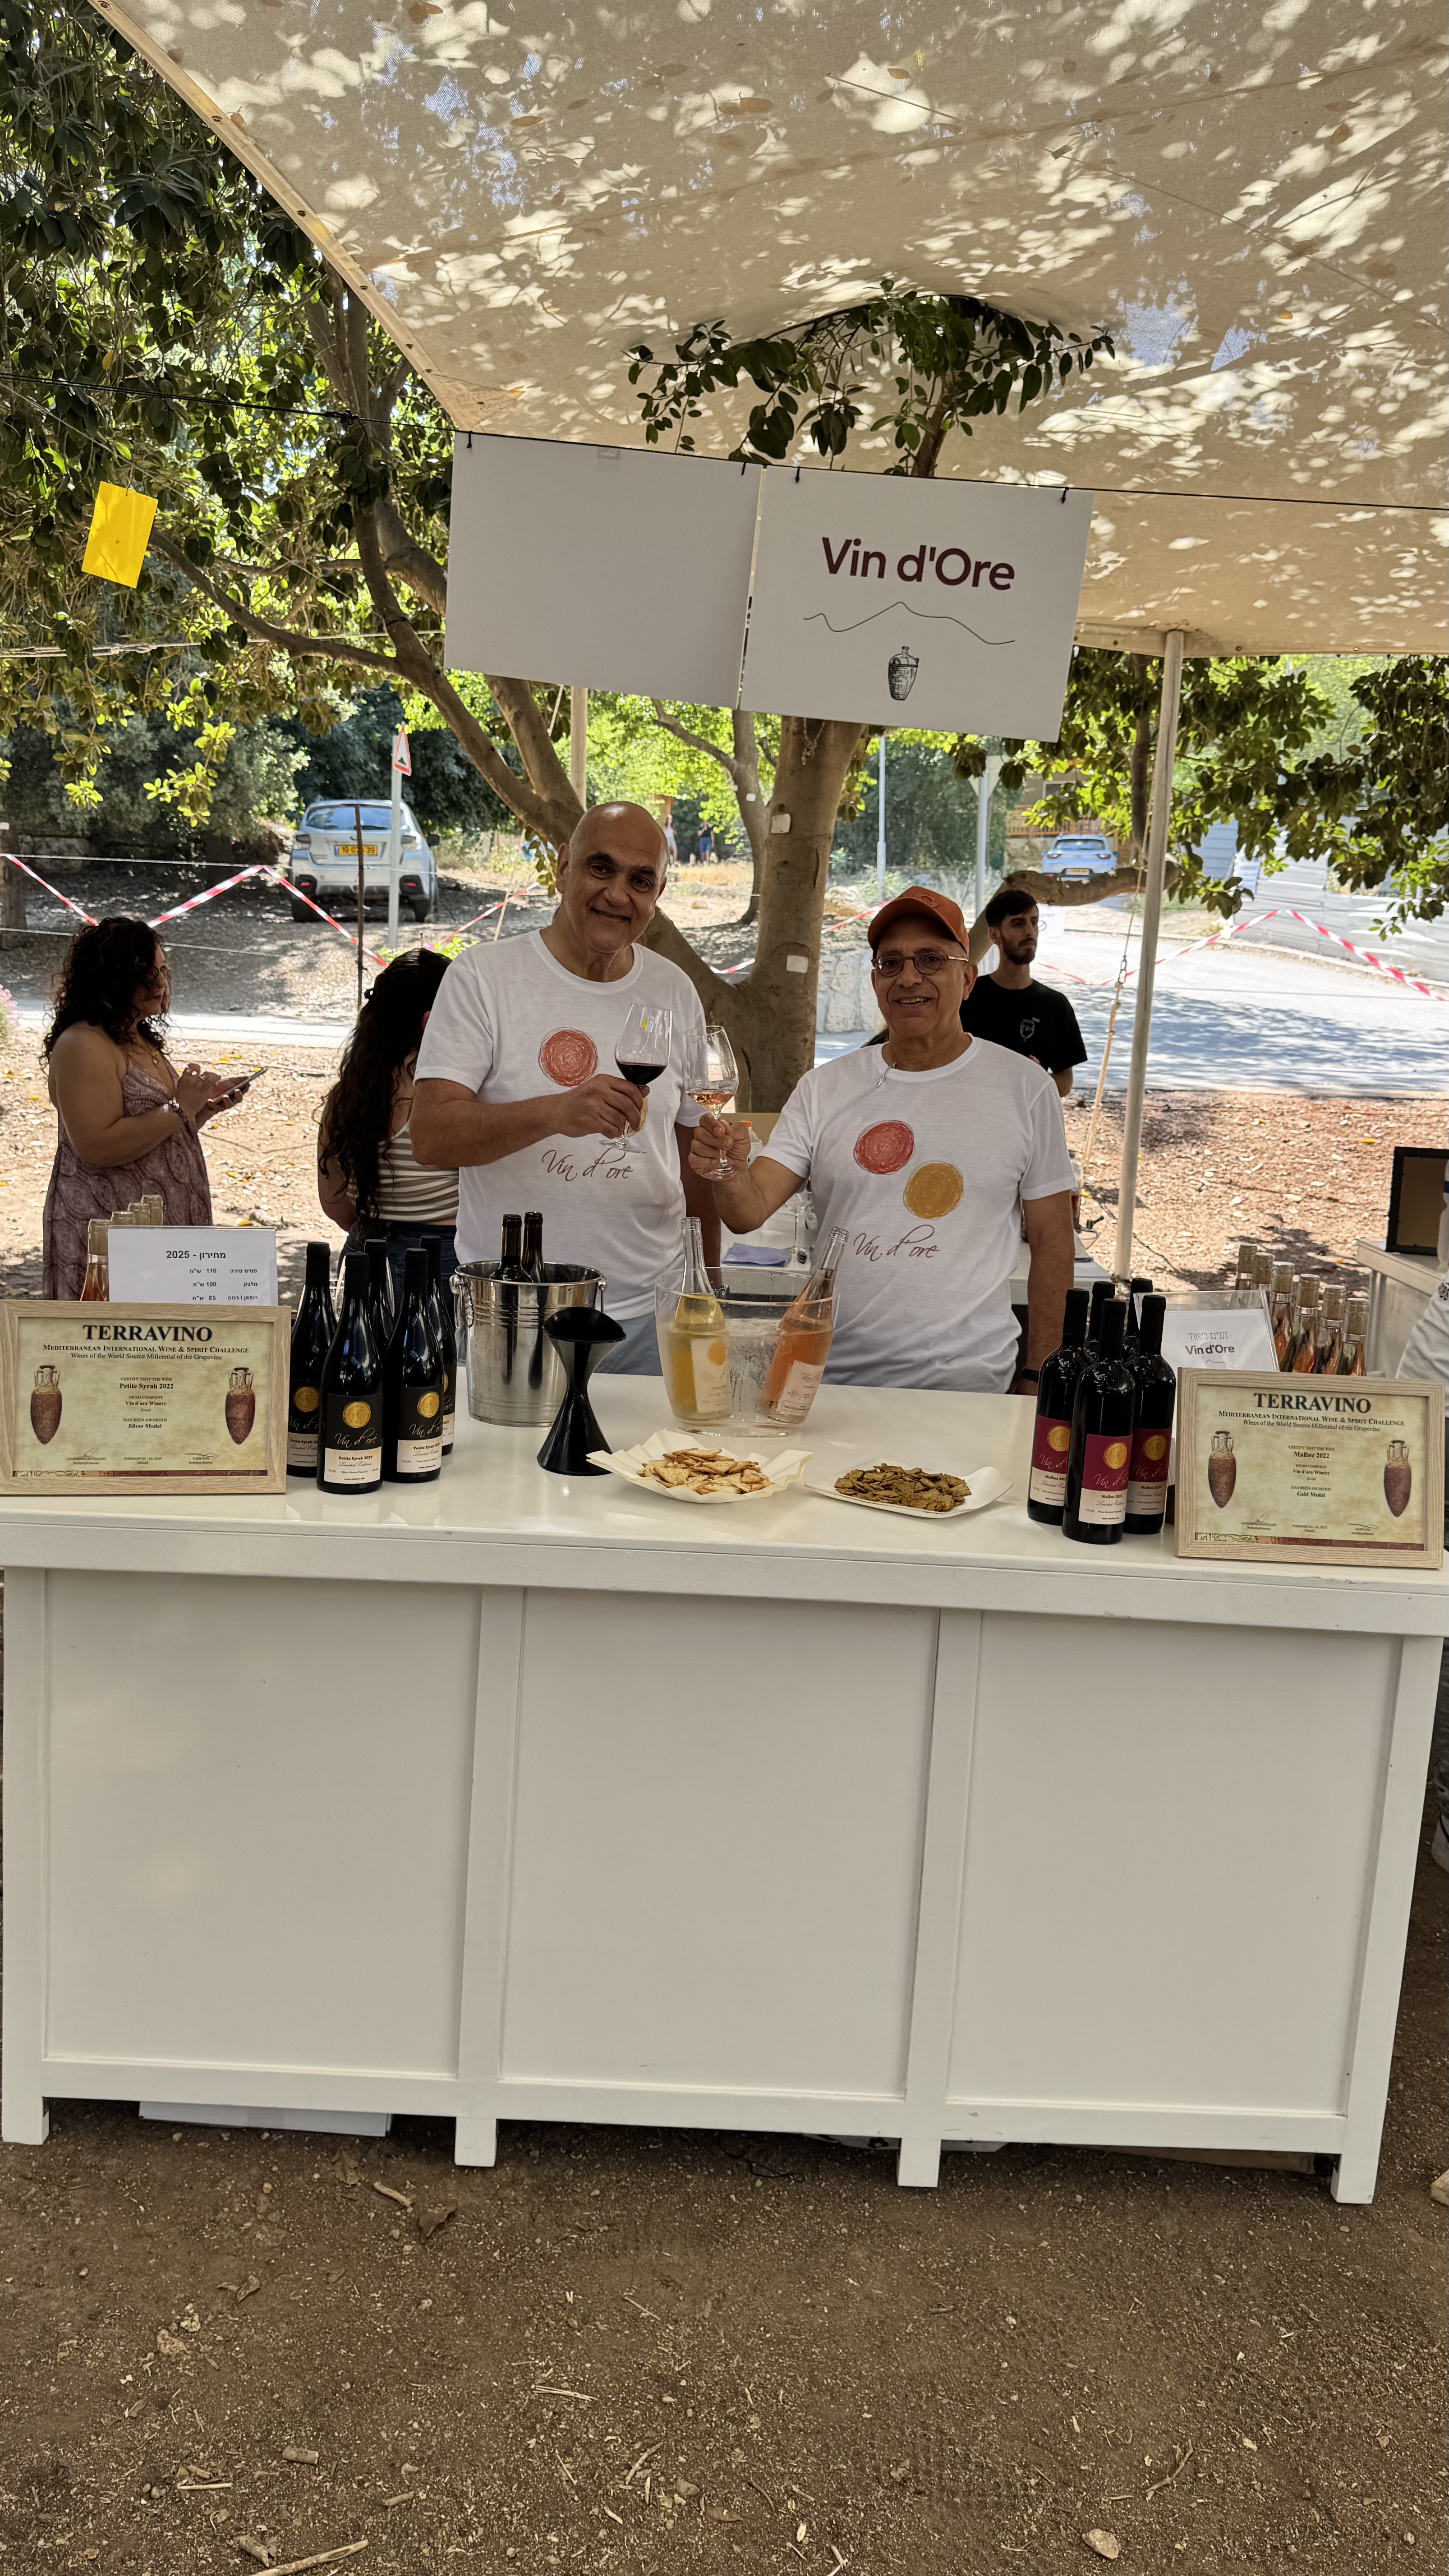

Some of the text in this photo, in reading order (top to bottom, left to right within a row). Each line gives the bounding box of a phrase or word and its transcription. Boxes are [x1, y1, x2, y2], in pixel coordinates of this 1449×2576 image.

[822, 537, 1015, 591] Vin d'Ore
[542, 1150, 577, 1181] Vin
[853, 1233, 882, 1261] Vin
[166, 1251, 190, 1259] 2025
[199, 1251, 226, 1260] מחירון
[83, 1325, 212, 1342] TERRAVINO
[1187, 1332, 1228, 1341] נעים מאוד
[1185, 1344, 1235, 1355] Vin d'Ore
[1253, 1393, 1371, 1413] TERRAVINO
[1219, 1411, 1270, 1419] MEDITERRANEAN
[1272, 1413, 1320, 1421] INTERNATIONAL
[409, 1424, 426, 1438] Vin
[334, 1433, 352, 1448] Vin
[1093, 1474, 1110, 1489] Vin
